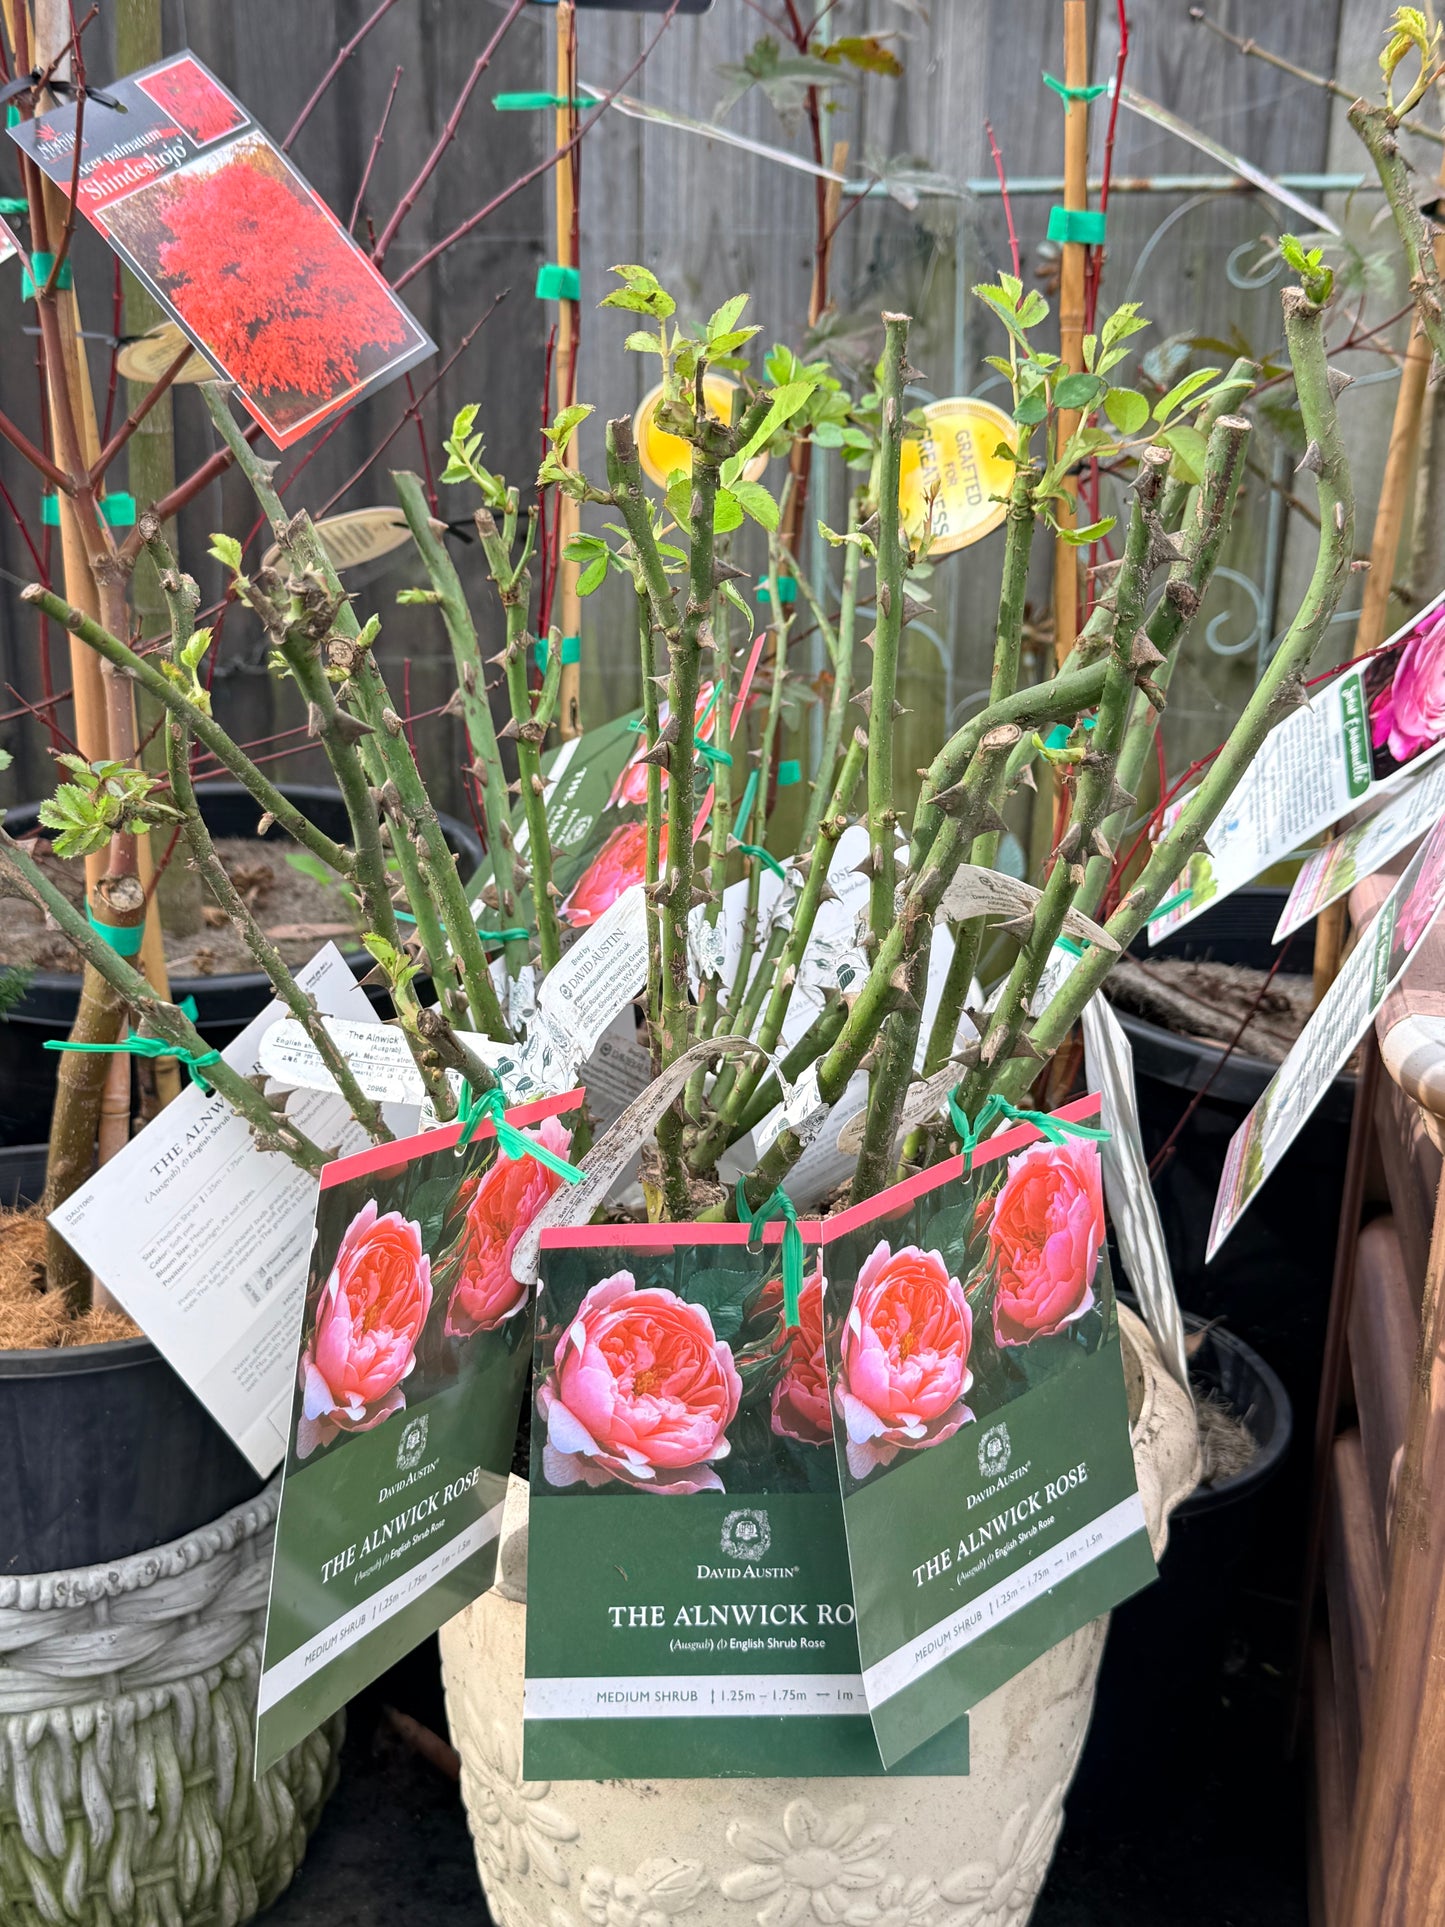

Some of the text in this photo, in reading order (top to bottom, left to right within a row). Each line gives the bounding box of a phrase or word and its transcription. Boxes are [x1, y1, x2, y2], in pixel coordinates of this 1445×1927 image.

[79, 156, 104, 176] Acer
[104, 129, 162, 166] palmatum
[945, 461, 957, 487] FOR
[955, 430, 982, 506] GRAFTED
[571, 945, 591, 967] Bred by
[610, 960, 630, 983] Bowling
[627, 943, 646, 962] Green
[568, 960, 594, 990] DAVID
[276, 1036, 301, 1047] English
[349, 1030, 364, 1040] The
[188, 1135, 212, 1160] English
[211, 1115, 231, 1136] Shrub
[150, 1142, 184, 1177] THE
[554, 1187, 570, 1203] The
[155, 1256, 177, 1278] Bloom
[378, 1480, 406, 1504] DAVID
[965, 1484, 996, 1510] DAVID
[321, 1466, 481, 1584] THE ALNWICK ROSE
[912, 1461, 1088, 1588] THE ALNWICK ROSE
[994, 1539, 1017, 1561] English
[1017, 1525, 1037, 1546] Shrub
[1037, 1514, 1055, 1532] Rose
[390, 1540, 411, 1560] English
[412, 1529, 430, 1548] Shrub
[430, 1518, 446, 1535] Rose
[696, 1565, 741, 1579] DAVID
[304, 1635, 338, 1666] MEDIUM
[339, 1614, 366, 1642] SHRUB
[378, 1592, 400, 1614] 1.25m
[408, 1572, 428, 1593] 1.75m
[608, 1603, 855, 1627] THE ALNWICK RO
[914, 1630, 951, 1663] MEDIUM
[953, 1611, 983, 1637] SHRUB
[995, 1587, 1018, 1609] 1.25m
[1027, 1567, 1050, 1587] 1.75m
[669, 1637, 826, 1652] (Ausgrab) English Shrub Rose
[596, 1689, 853, 1703] MEDIUM SHRUB 1.25m 1.75m 1m
